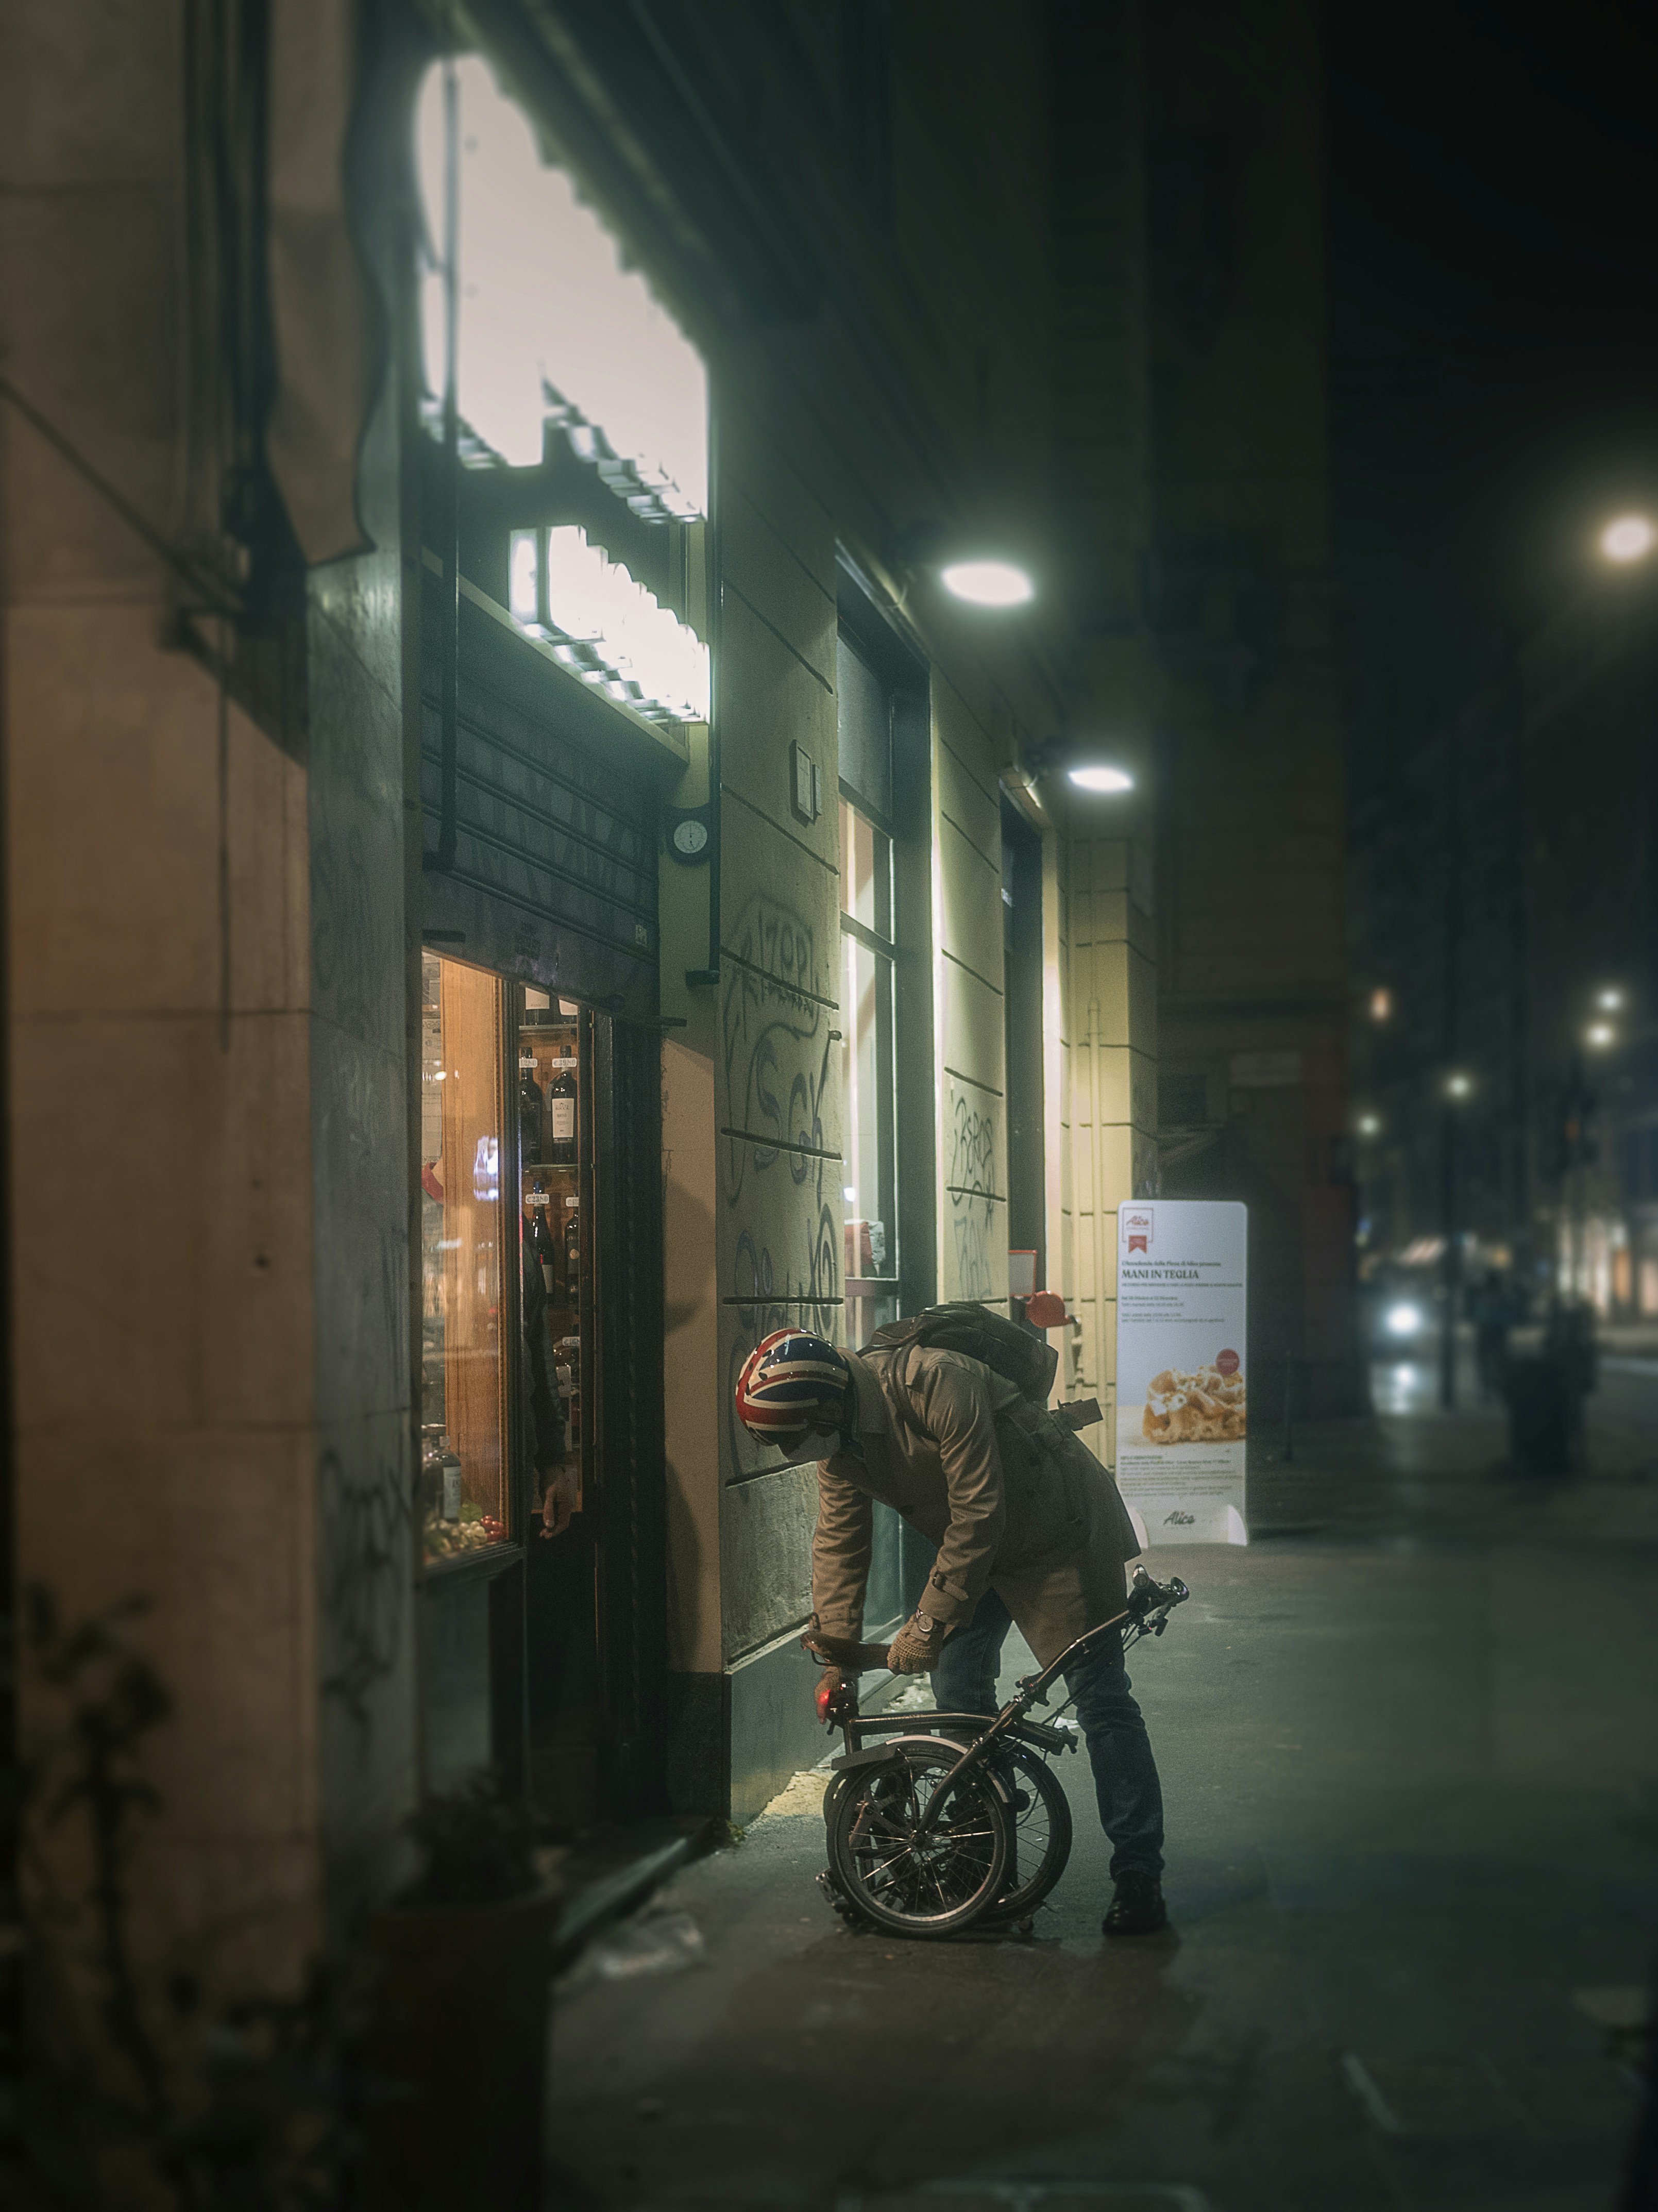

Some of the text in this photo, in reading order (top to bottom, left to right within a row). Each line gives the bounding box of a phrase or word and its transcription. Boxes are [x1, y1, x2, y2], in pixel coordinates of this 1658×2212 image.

[1122, 1269, 1199, 1279] MANI IN TEGLIA
